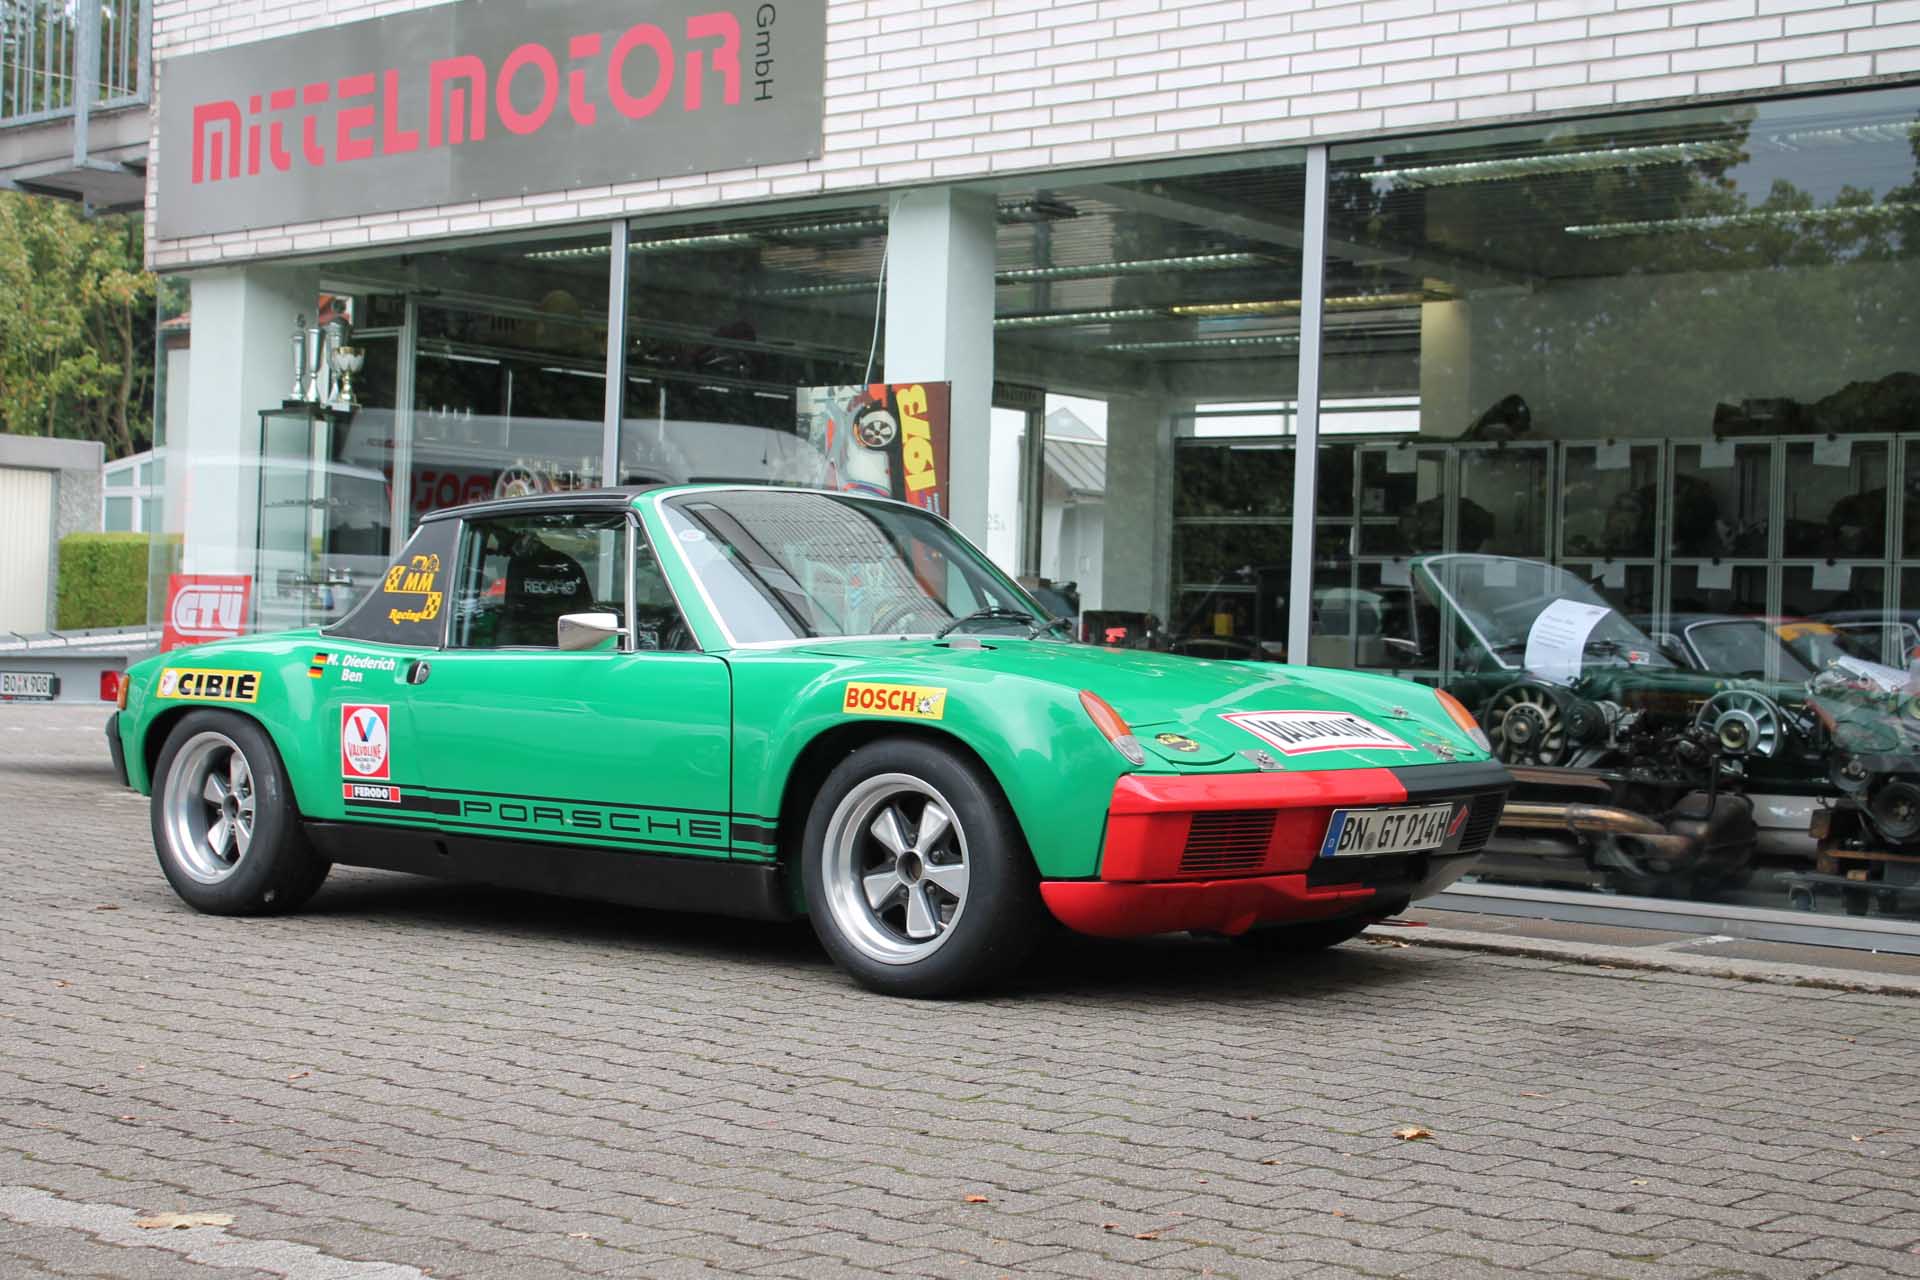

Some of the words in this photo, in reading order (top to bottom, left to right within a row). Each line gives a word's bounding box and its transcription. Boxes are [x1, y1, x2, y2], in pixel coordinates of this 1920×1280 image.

[754, 3, 776, 101] GmbH
[403, 572, 435, 591] MM
[523, 580, 577, 595] RECARO
[388, 607, 424, 625] Racing
[326, 653, 339, 666] M.
[342, 654, 396, 671] Diederich
[341, 668, 363, 682] Ben
[846, 687, 916, 712] BOSCH
[1242, 717, 1394, 744] VALVOLINE
[348, 743, 383, 760] VALVOLINE
[353, 786, 389, 799] FERODO
[463, 800, 722, 840] PORSCHE
[1337, 816, 1371, 851] BN
[1377, 813, 1406, 849] GT
[1403, 810, 1450, 846] 914H
